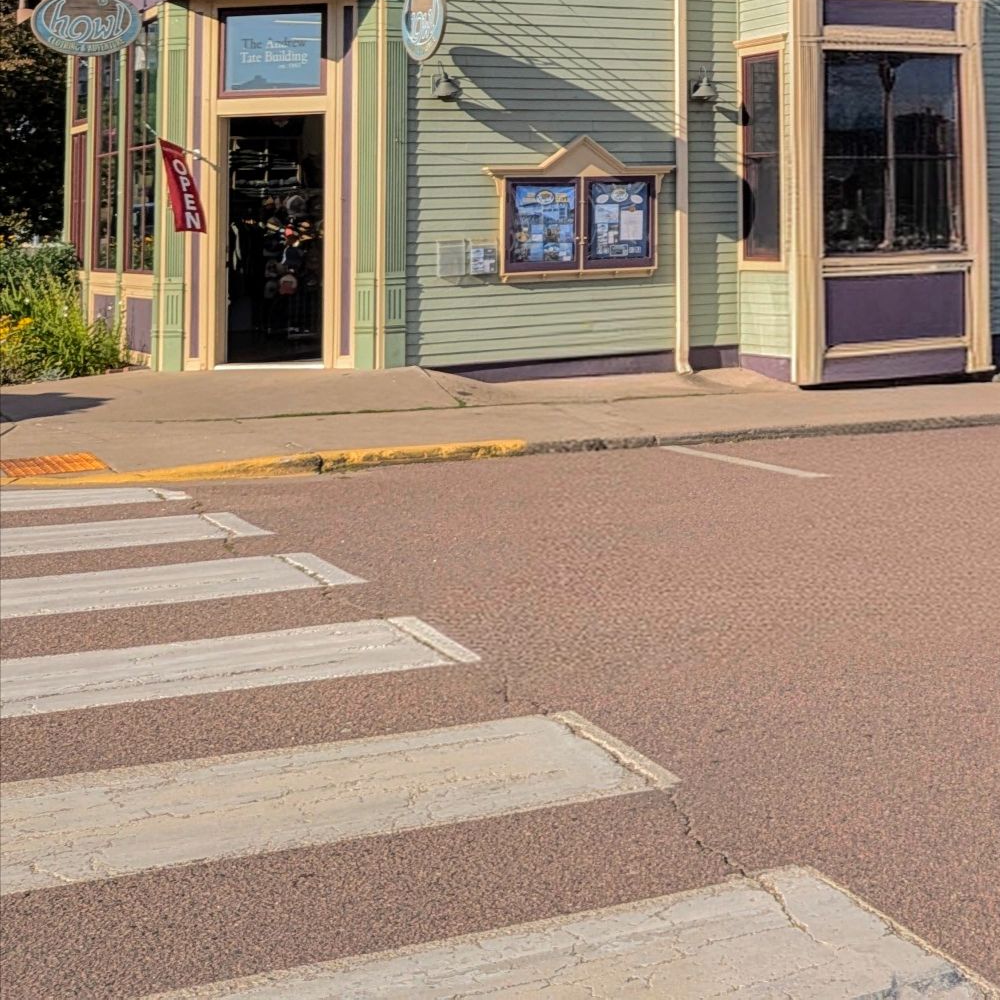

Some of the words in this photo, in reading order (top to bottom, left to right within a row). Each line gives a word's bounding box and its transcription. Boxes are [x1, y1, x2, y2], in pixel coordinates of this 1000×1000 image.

[48, 0, 125, 41] howl
[241, 38, 262, 49] The
[265, 37, 306, 49] Andrew
[240, 51, 262, 64] Tate
[265, 50, 308, 65] Building
[172, 158, 201, 230] OPEN
